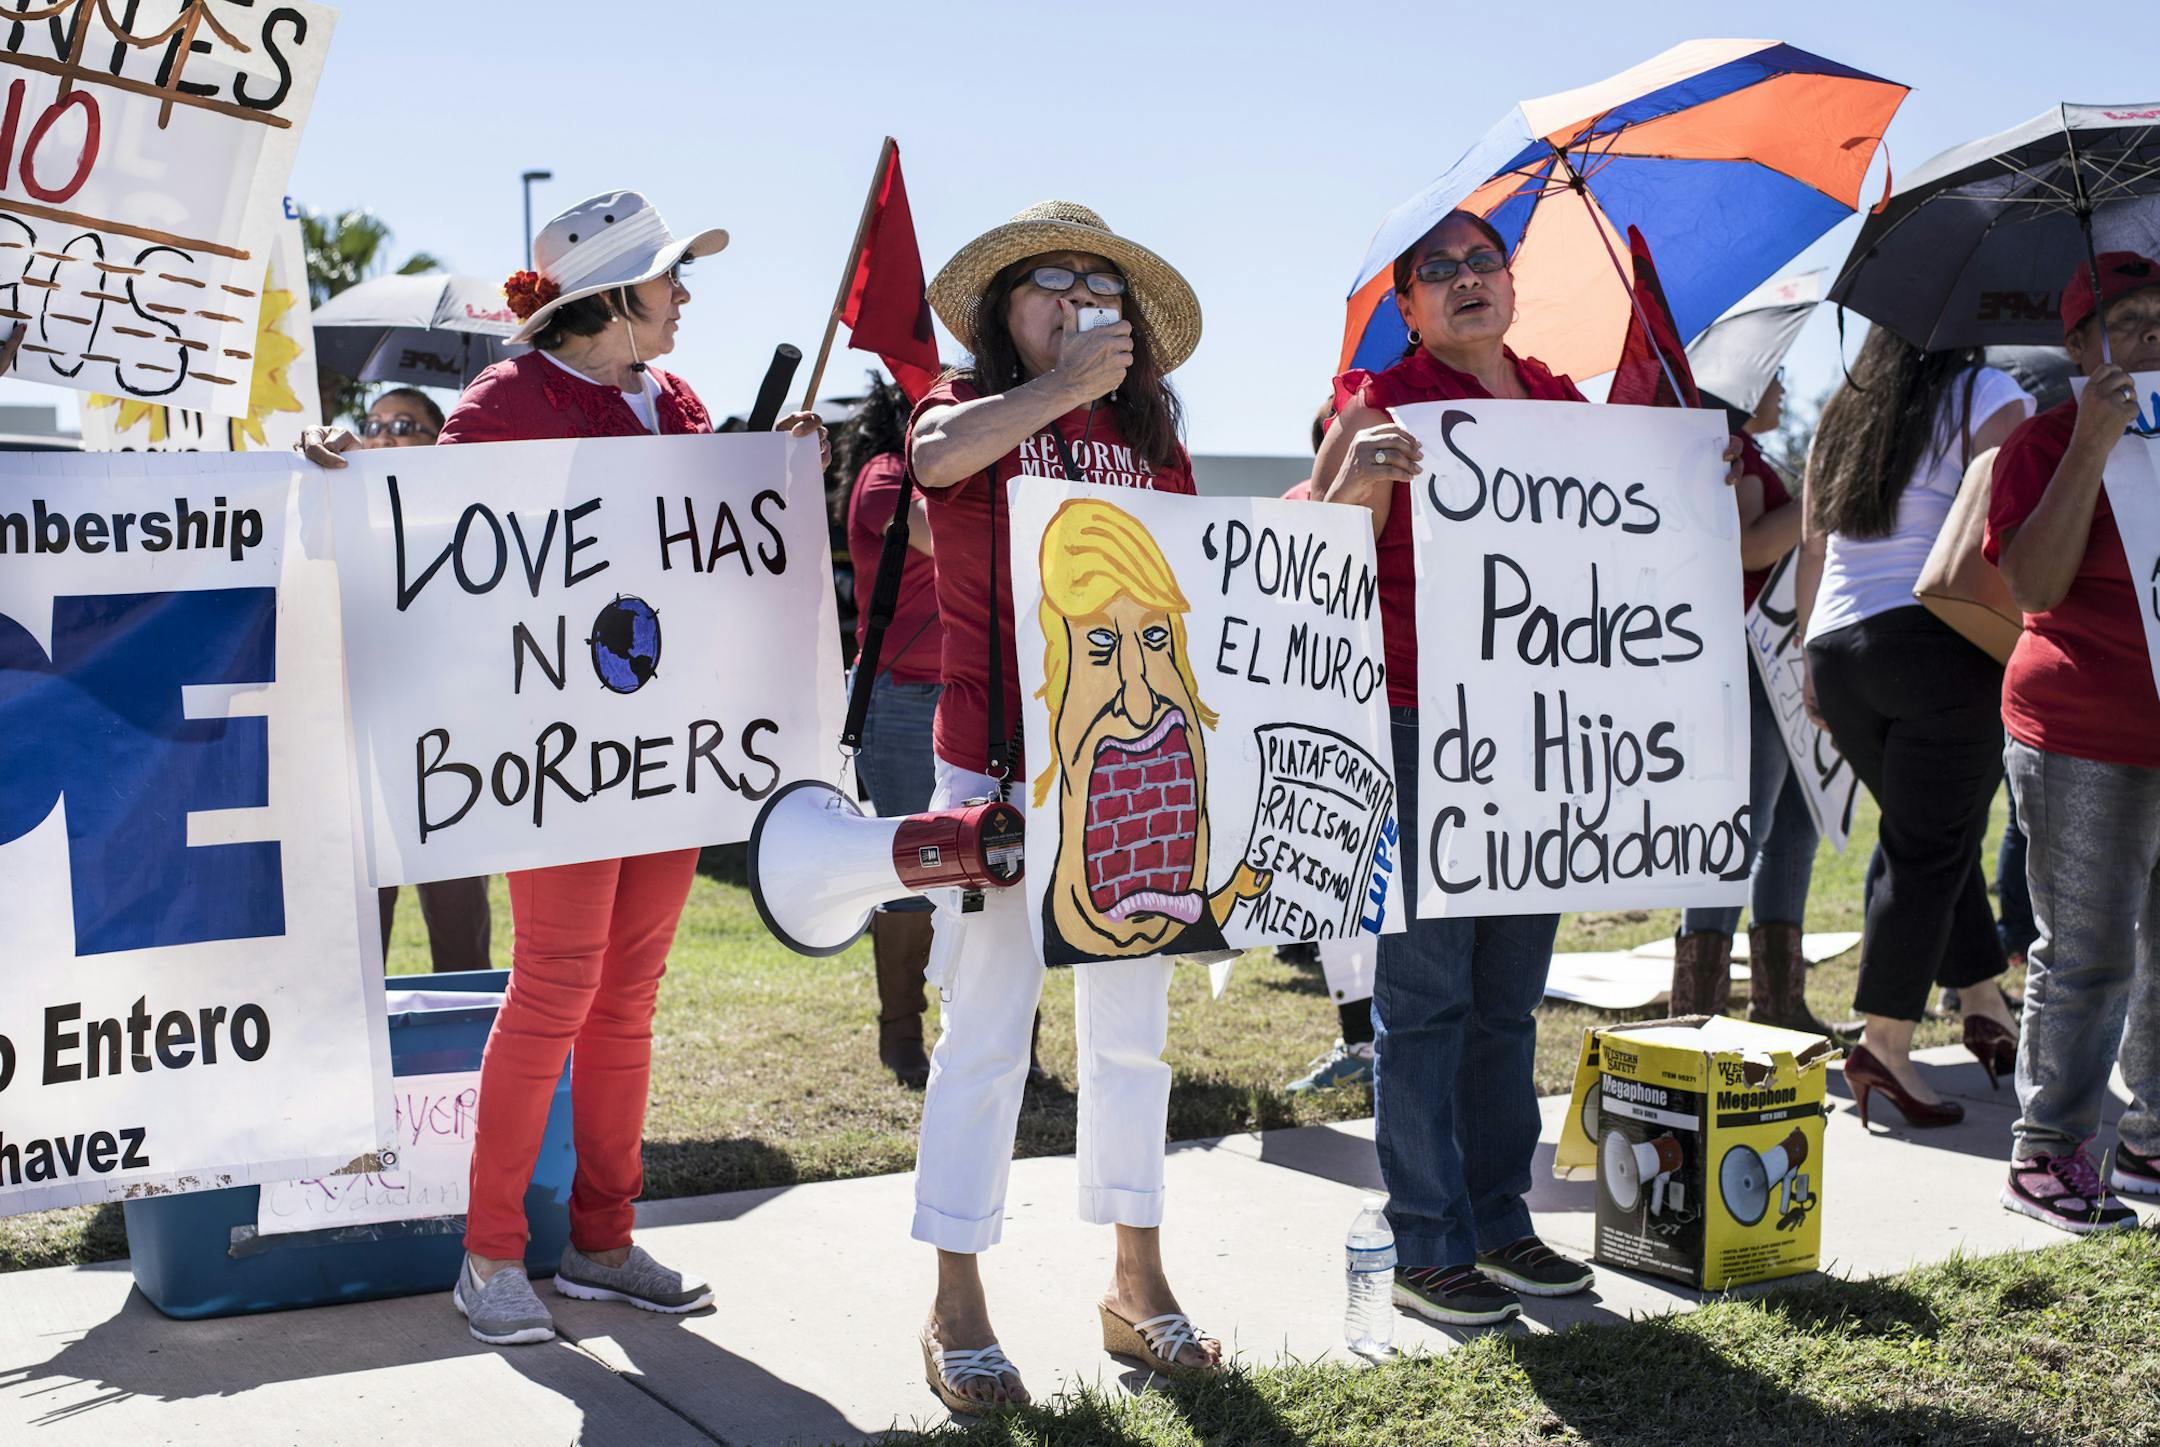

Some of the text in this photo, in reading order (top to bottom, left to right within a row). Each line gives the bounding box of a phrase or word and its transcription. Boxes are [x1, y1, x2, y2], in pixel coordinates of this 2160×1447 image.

[1019, 433, 1156, 476] REORMA
[1428, 409, 1661, 534] Somos
[386, 475, 787, 612] LOVE HAS
[1216, 616, 1271, 685] EL
[1481, 553, 1704, 668] Padres
[416, 718, 781, 844] BORDERS
[1268, 735, 1382, 810] PLATAFORMA
[1433, 683, 1497, 784] de
[1534, 689, 1685, 829] Hijos
[1429, 800, 1752, 895] Ciudadanos
[42, 995, 271, 1086] Entero
[1603, 1045, 1638, 1065] WESTERN
[1608, 1058, 1637, 1075] SAFETY
[1602, 1073, 1668, 1106] Megaphone
[1716, 1087, 1797, 1111] Megaphone
